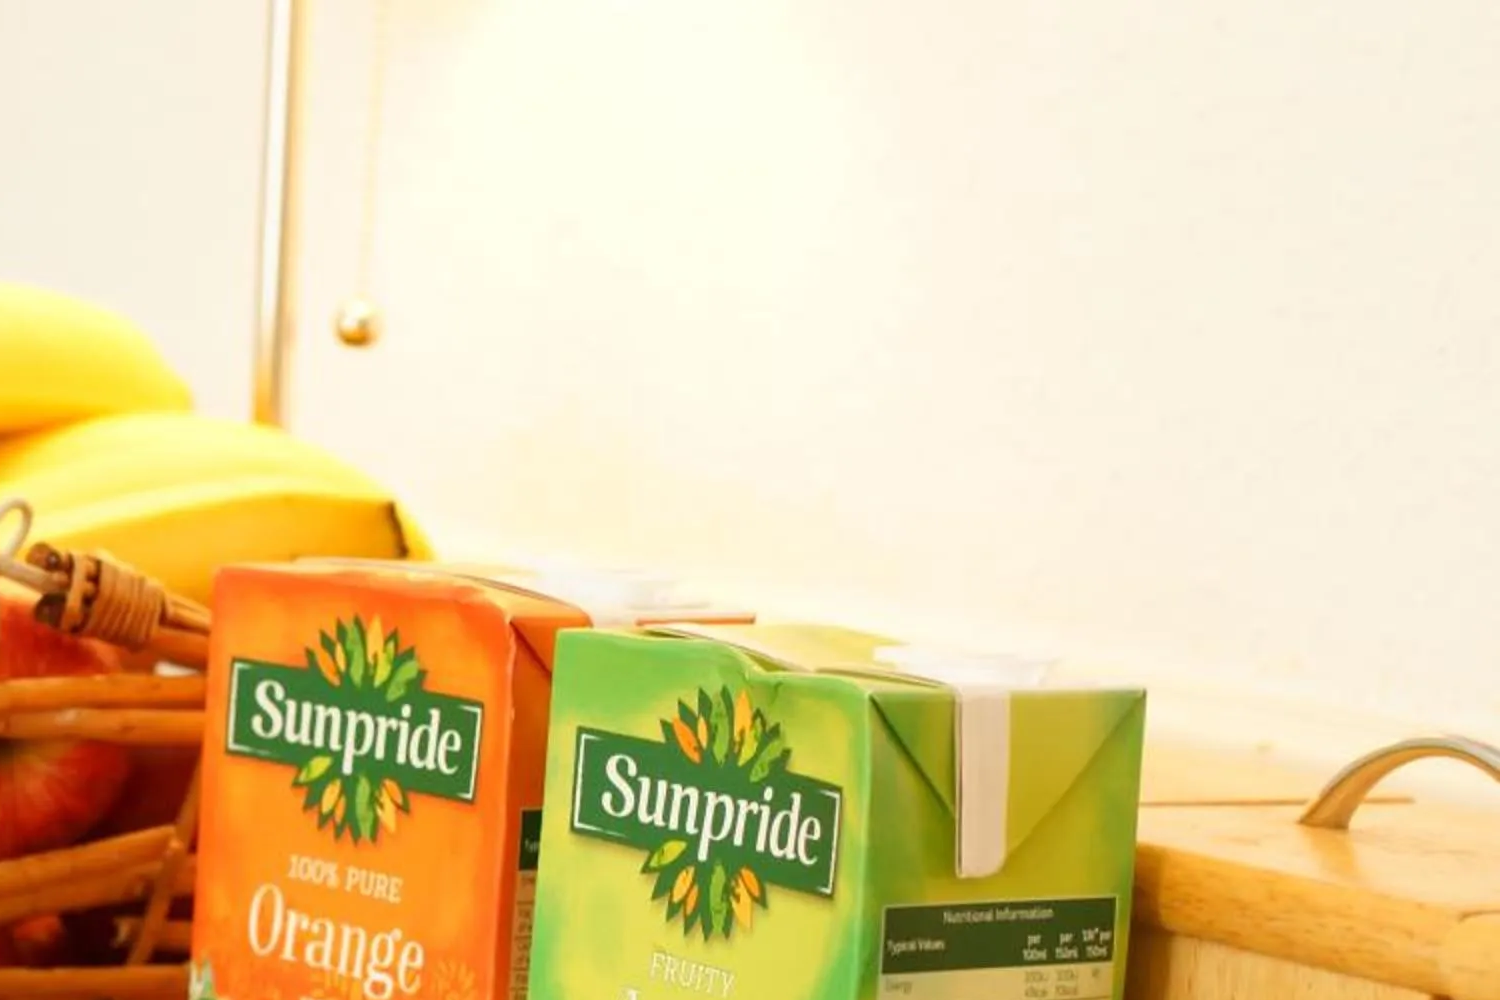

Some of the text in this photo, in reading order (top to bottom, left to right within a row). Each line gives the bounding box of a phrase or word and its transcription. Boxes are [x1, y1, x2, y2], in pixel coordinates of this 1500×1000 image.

[251, 679, 462, 775] Sunpride
[601, 753, 821, 866] Sunpride
[288, 854, 403, 903] 100% PURE
[943, 907, 1054, 924] Nutritional Information
[248, 883, 425, 1000] Orange
[887, 939, 945, 955] Typical Values
[1028, 935, 1041, 945] per
[1060, 933, 1073, 944] per
[650, 951, 736, 995] FRUITY
